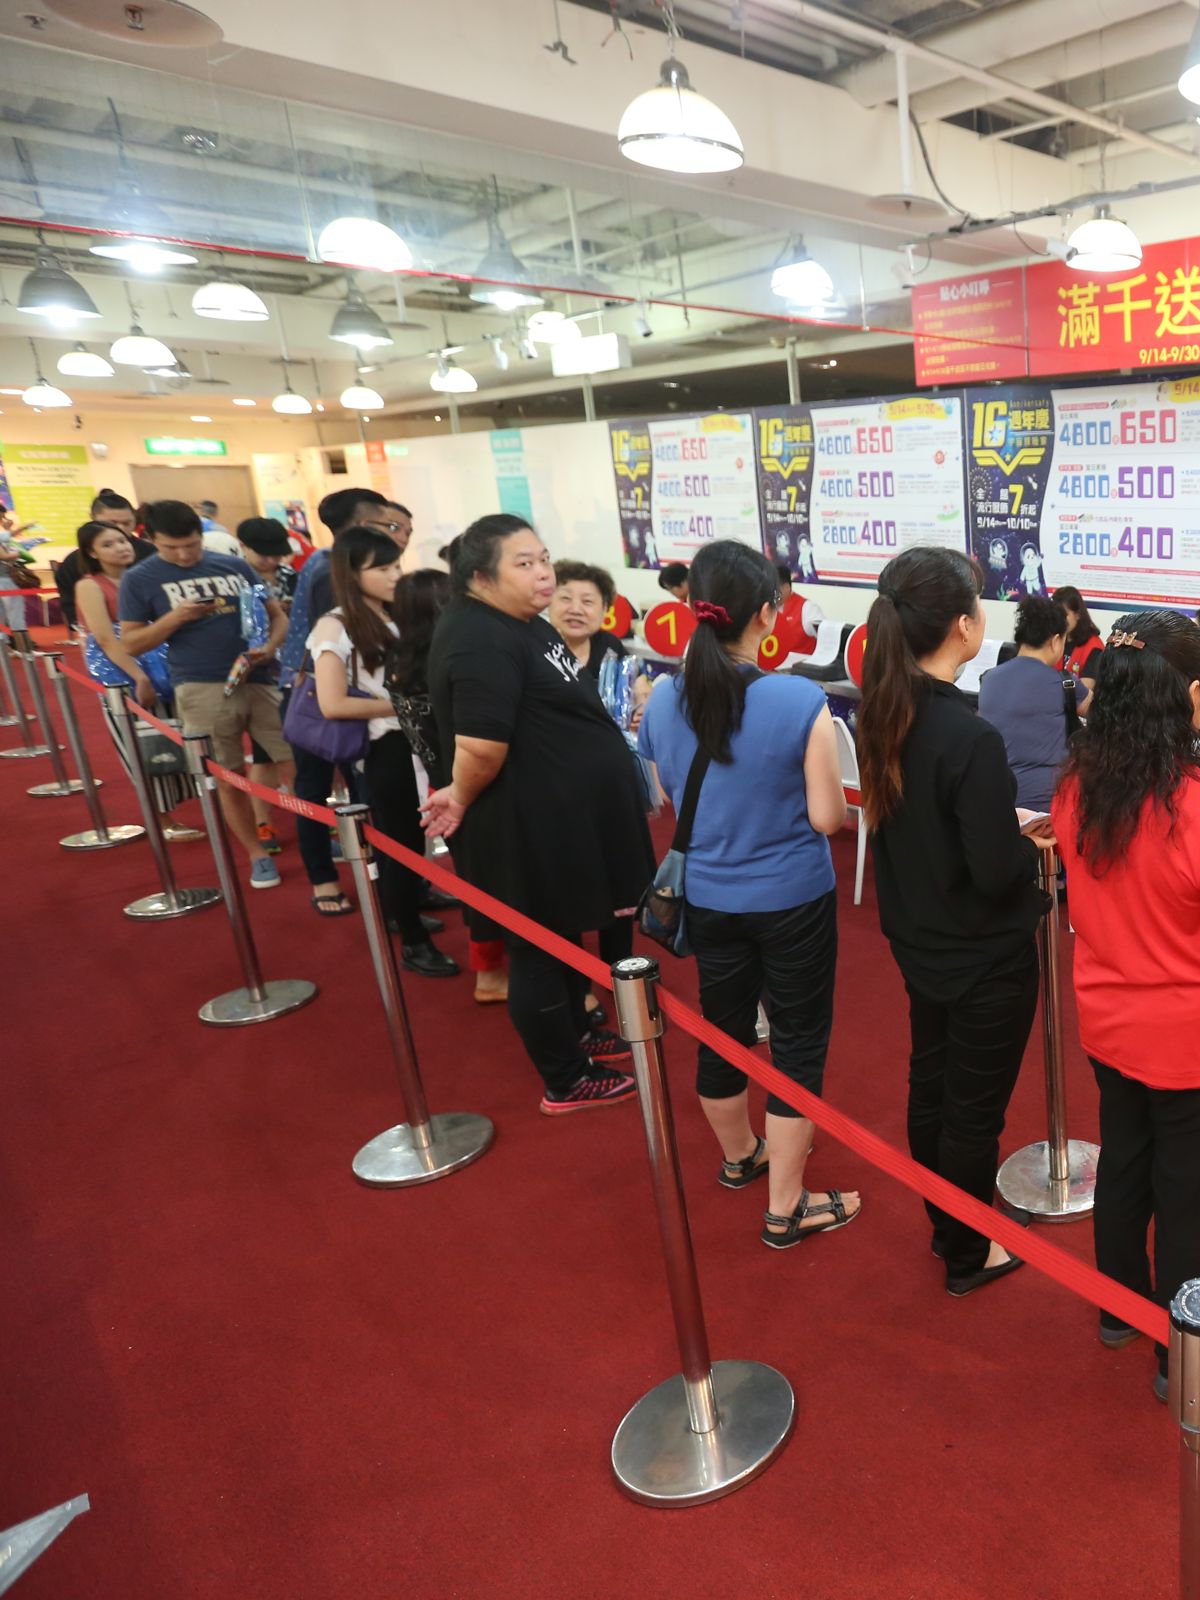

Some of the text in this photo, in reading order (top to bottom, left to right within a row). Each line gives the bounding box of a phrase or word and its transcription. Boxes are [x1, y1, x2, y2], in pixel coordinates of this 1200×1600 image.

[1139, 345, 1200, 364] 9/14-9/30
[972, 400, 1008, 448] 16
[1059, 421, 1111, 446] 4800
[1120, 409, 1176, 445] 650
[682, 437, 708, 460] 650
[819, 426, 893, 455] 4800 650
[684, 475, 710, 497] 500
[821, 471, 894, 497] 4800 500
[1059, 466, 1174, 499] 4800 500
[1008, 484, 1024, 516] 7
[689, 516, 714, 537] 400
[861, 520, 897, 546] 400
[1059, 526, 1174, 559] 2800 400
[656, 610, 677, 645] 7
